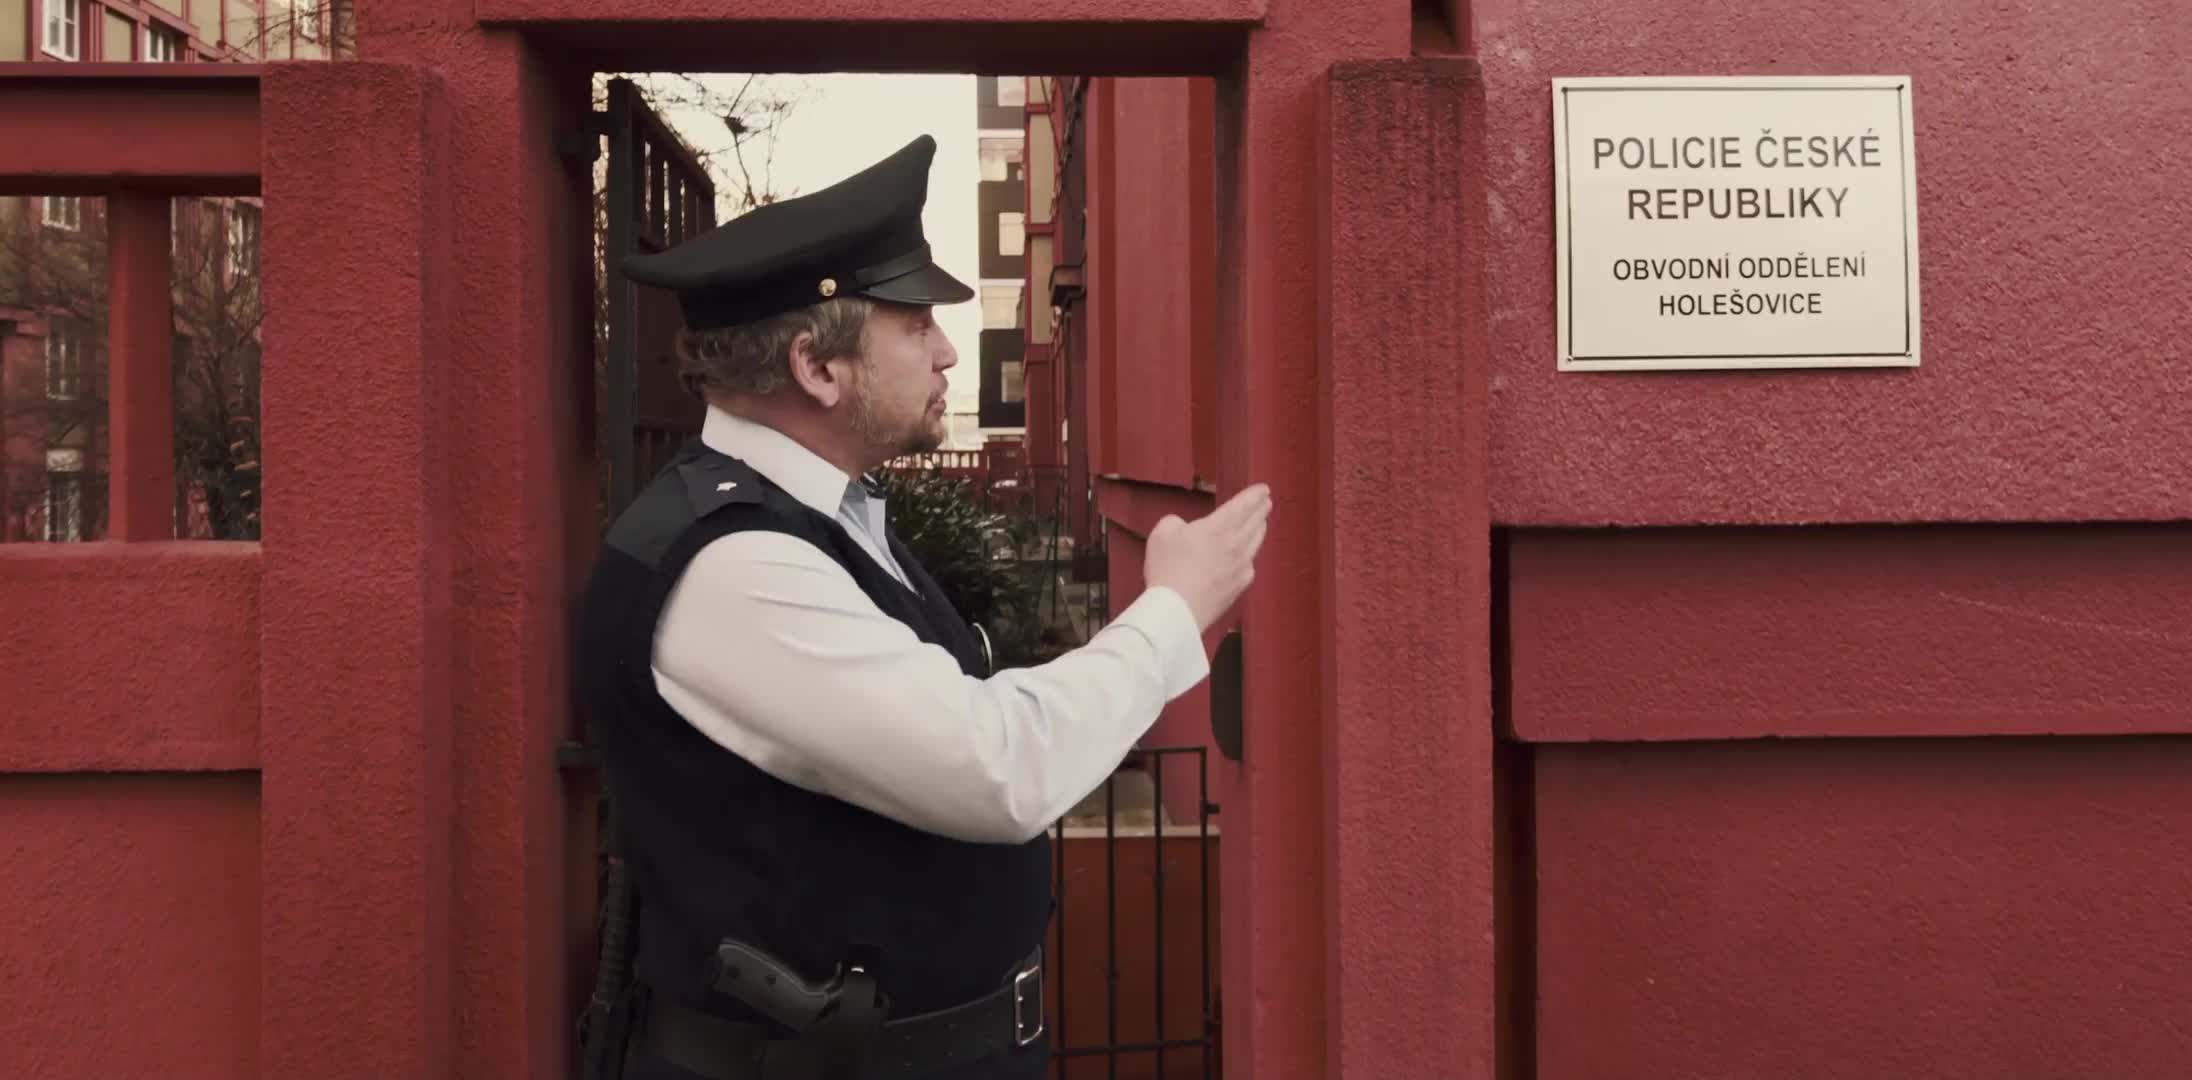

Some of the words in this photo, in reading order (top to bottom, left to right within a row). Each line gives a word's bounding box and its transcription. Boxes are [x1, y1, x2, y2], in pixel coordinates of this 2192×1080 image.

[1593, 136, 1742, 169] POLICIE
[1755, 128, 1881, 168] ČESKÉ
[1628, 187, 1849, 219] REPUBLIKY
[1613, 253, 1730, 280] OBVODNÍ
[1738, 251, 1866, 278] ODDĚLENÍ
[1659, 289, 1823, 316] HOLEŠOVICE
